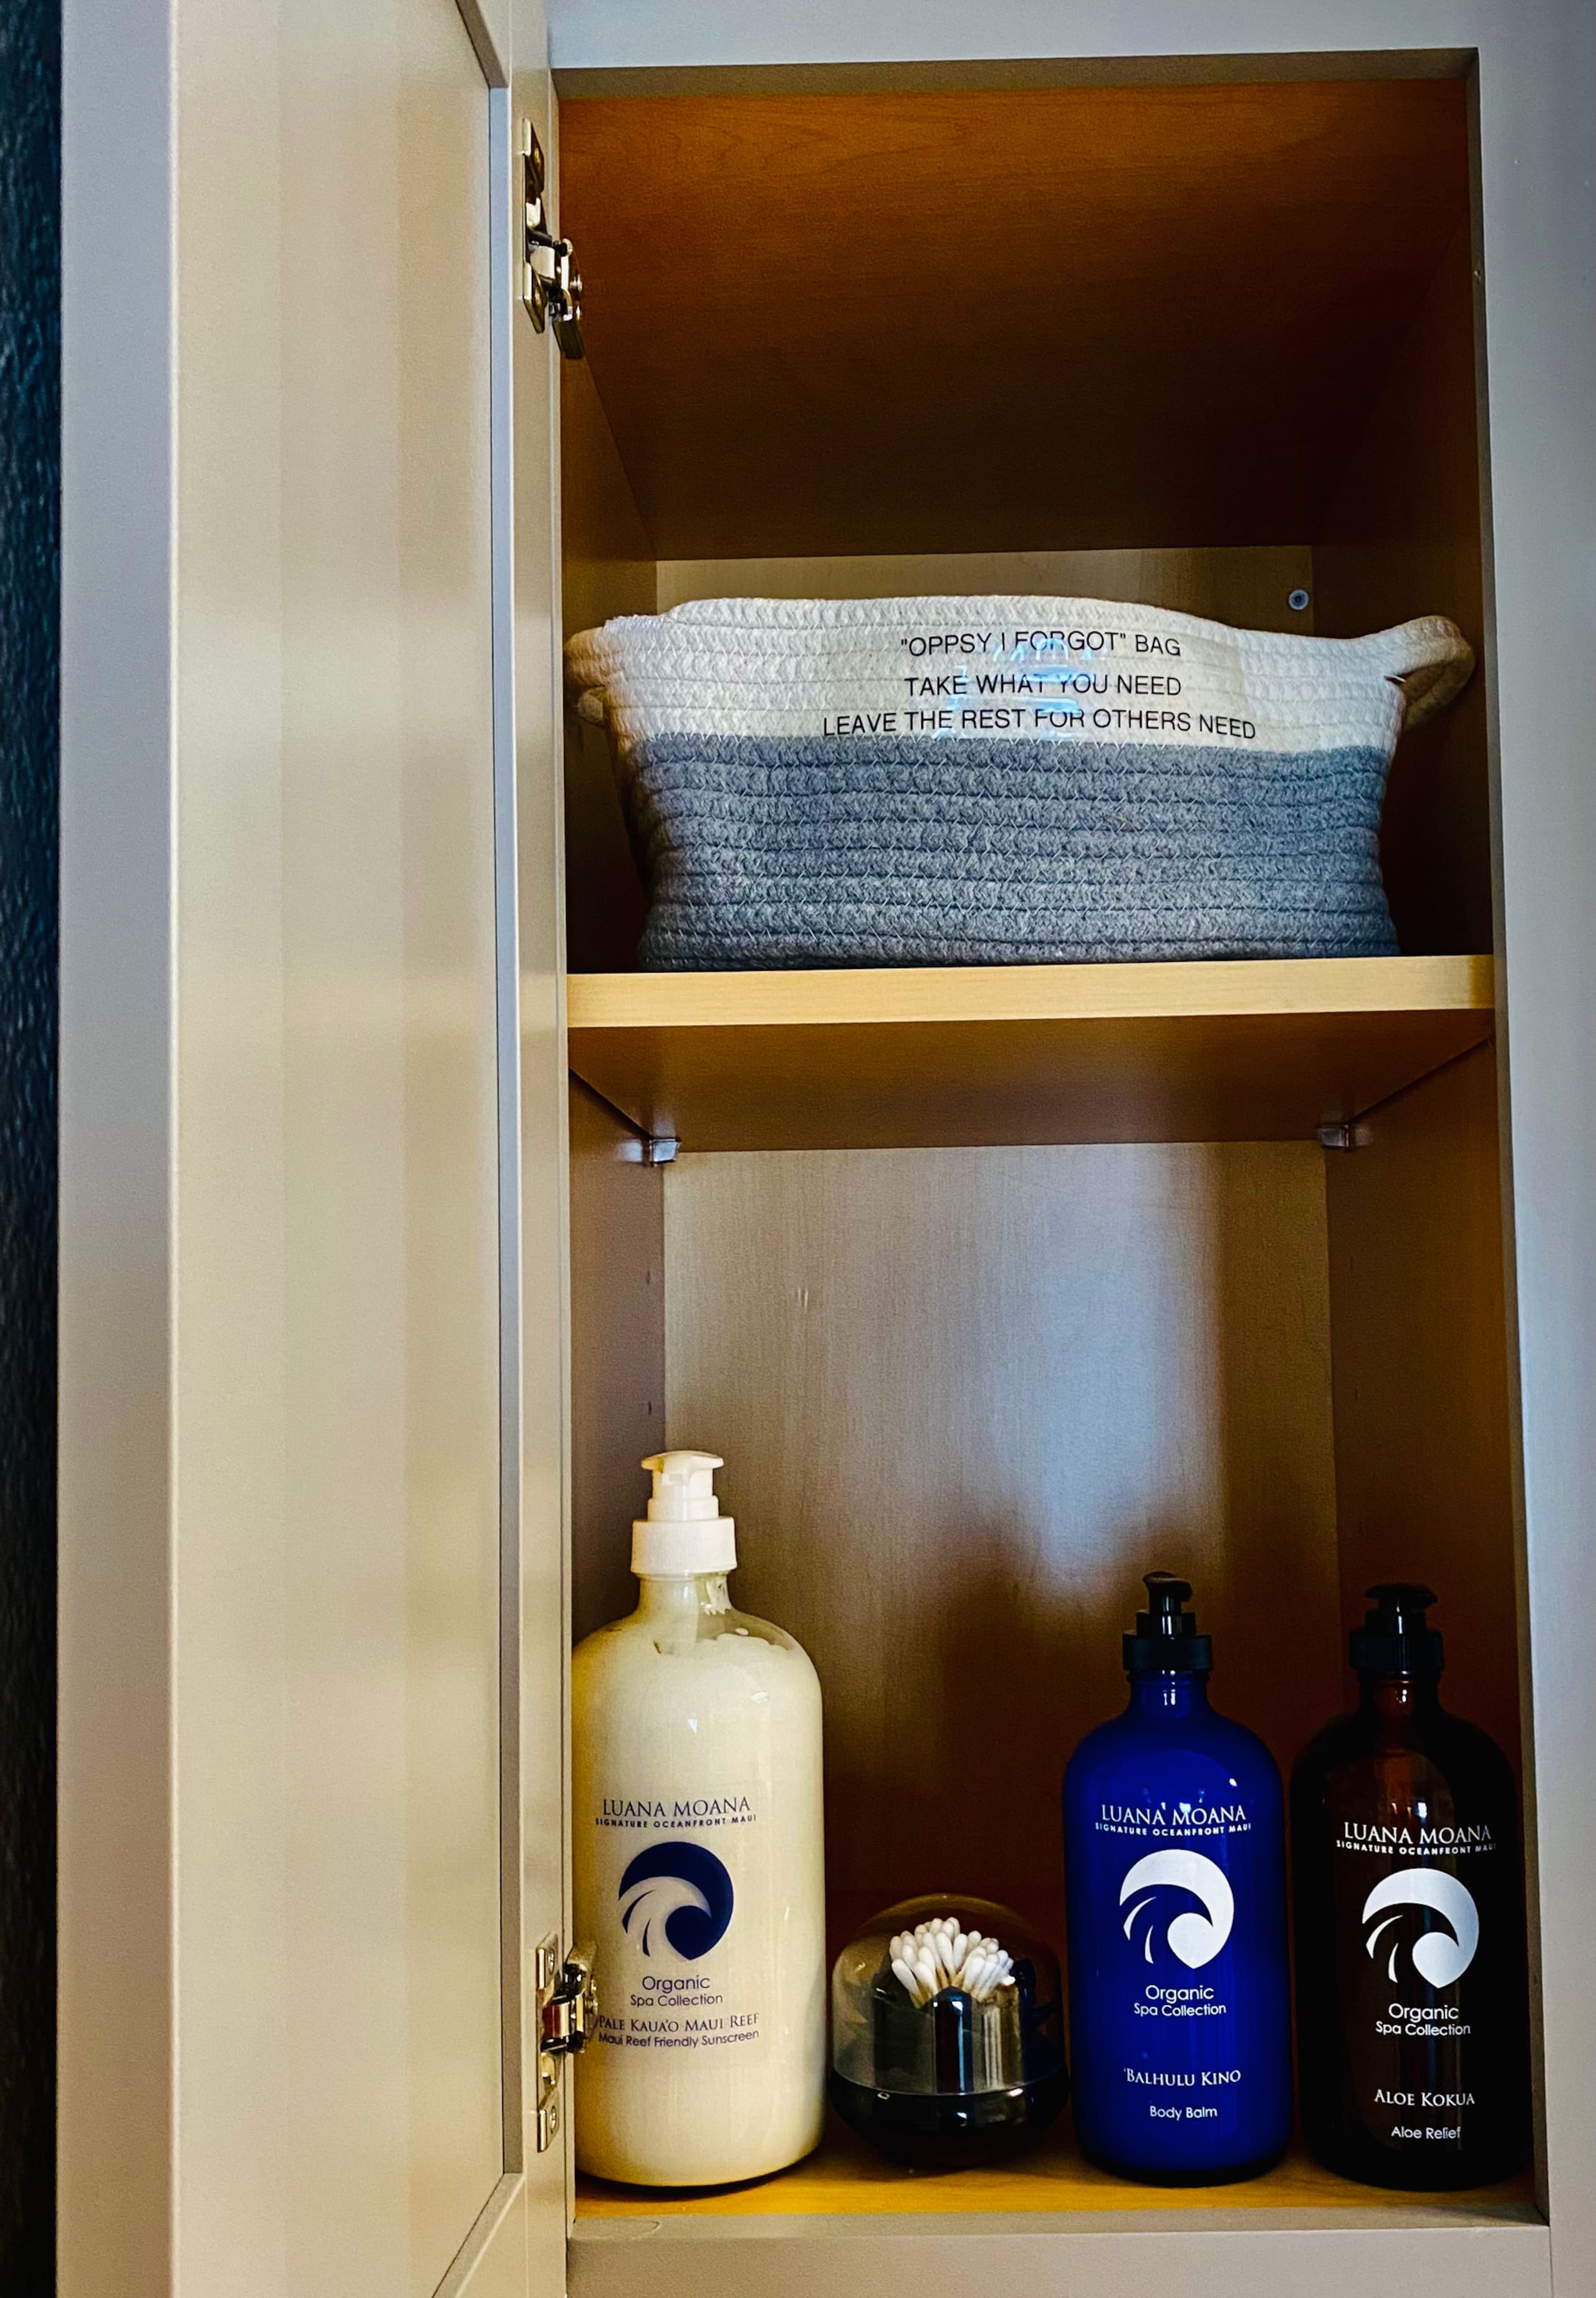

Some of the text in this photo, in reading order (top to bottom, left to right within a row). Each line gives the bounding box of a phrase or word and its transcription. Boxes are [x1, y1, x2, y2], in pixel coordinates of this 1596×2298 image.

[901, 631, 1181, 656] "OPPSY I FORGOT" BAG
[904, 674, 1181, 696] TAKE WHAT YOU NEED
[824, 709, 1256, 739] LEAVE THE REST FOR OTHERS NEED
[603, 1796, 751, 1817] LUANA MOANA
[1102, 1804, 1246, 1825] LUANA MOANA
[595, 1814, 756, 1828] SIGNATURE OCEANFRONT MAUI
[1095, 1822, 1251, 1836] SIGNATURE OCEANFRONT MAUI
[1344, 1822, 1491, 1844] LUANA MOANA
[1336, 1840, 1394, 1854] SIGNATURE
[1399, 1846, 1471, 1855] OCEANFRONT
[642, 1975, 710, 1994] Organic
[630, 1994, 723, 2007] Spa Collection
[1145, 1984, 1214, 2004] Organic
[1134, 2002, 1227, 2017] Spa Collection
[1388, 2002, 1459, 2023] Organic
[685, 2019, 723, 2031] MAUI
[730, 2013, 759, 2027] REEF
[1375, 2021, 1471, 2036] Spa Collection
[598, 2031, 759, 2049] Maui Reef Friendly Sunscreen
[1201, 2070, 1241, 2086] KINO
[1374, 2089, 1475, 2107] ALOE KOKUA
[1150, 2105, 1218, 2121] Body Balm
[1391, 2126, 1461, 2139] Aloe Relief
